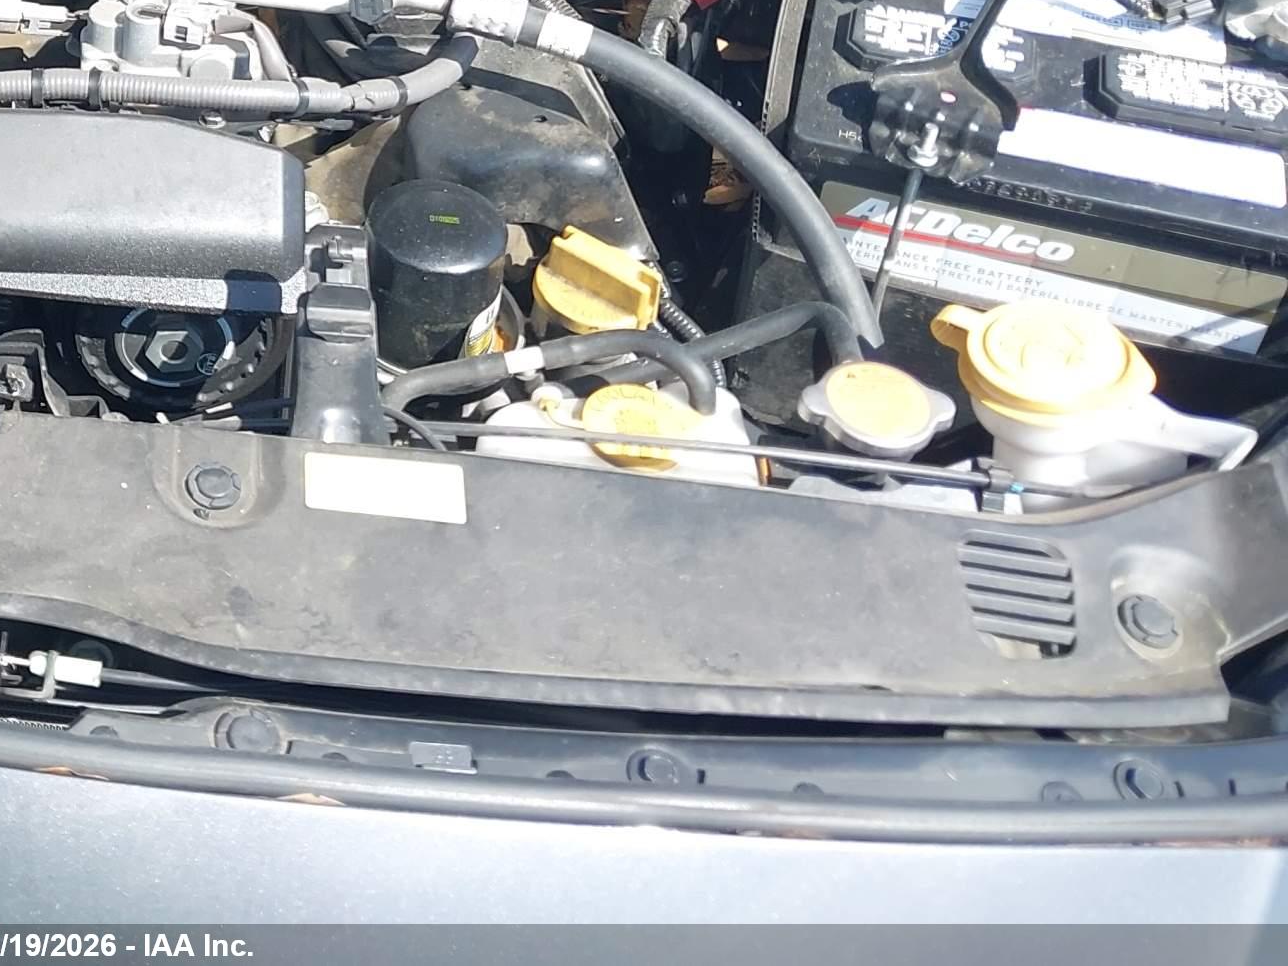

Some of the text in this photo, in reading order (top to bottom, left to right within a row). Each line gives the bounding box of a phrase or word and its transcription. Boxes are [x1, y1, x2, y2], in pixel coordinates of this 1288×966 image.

[846, 197, 1075, 262] ACDelco
[842, 236, 1044, 289] NTEANCE FREE BATTERY
[894, 260, 919, 270] ANS
[924, 265, 993, 287] ENTRETIEN
[1064, 296, 1102, 311] LIBRE
